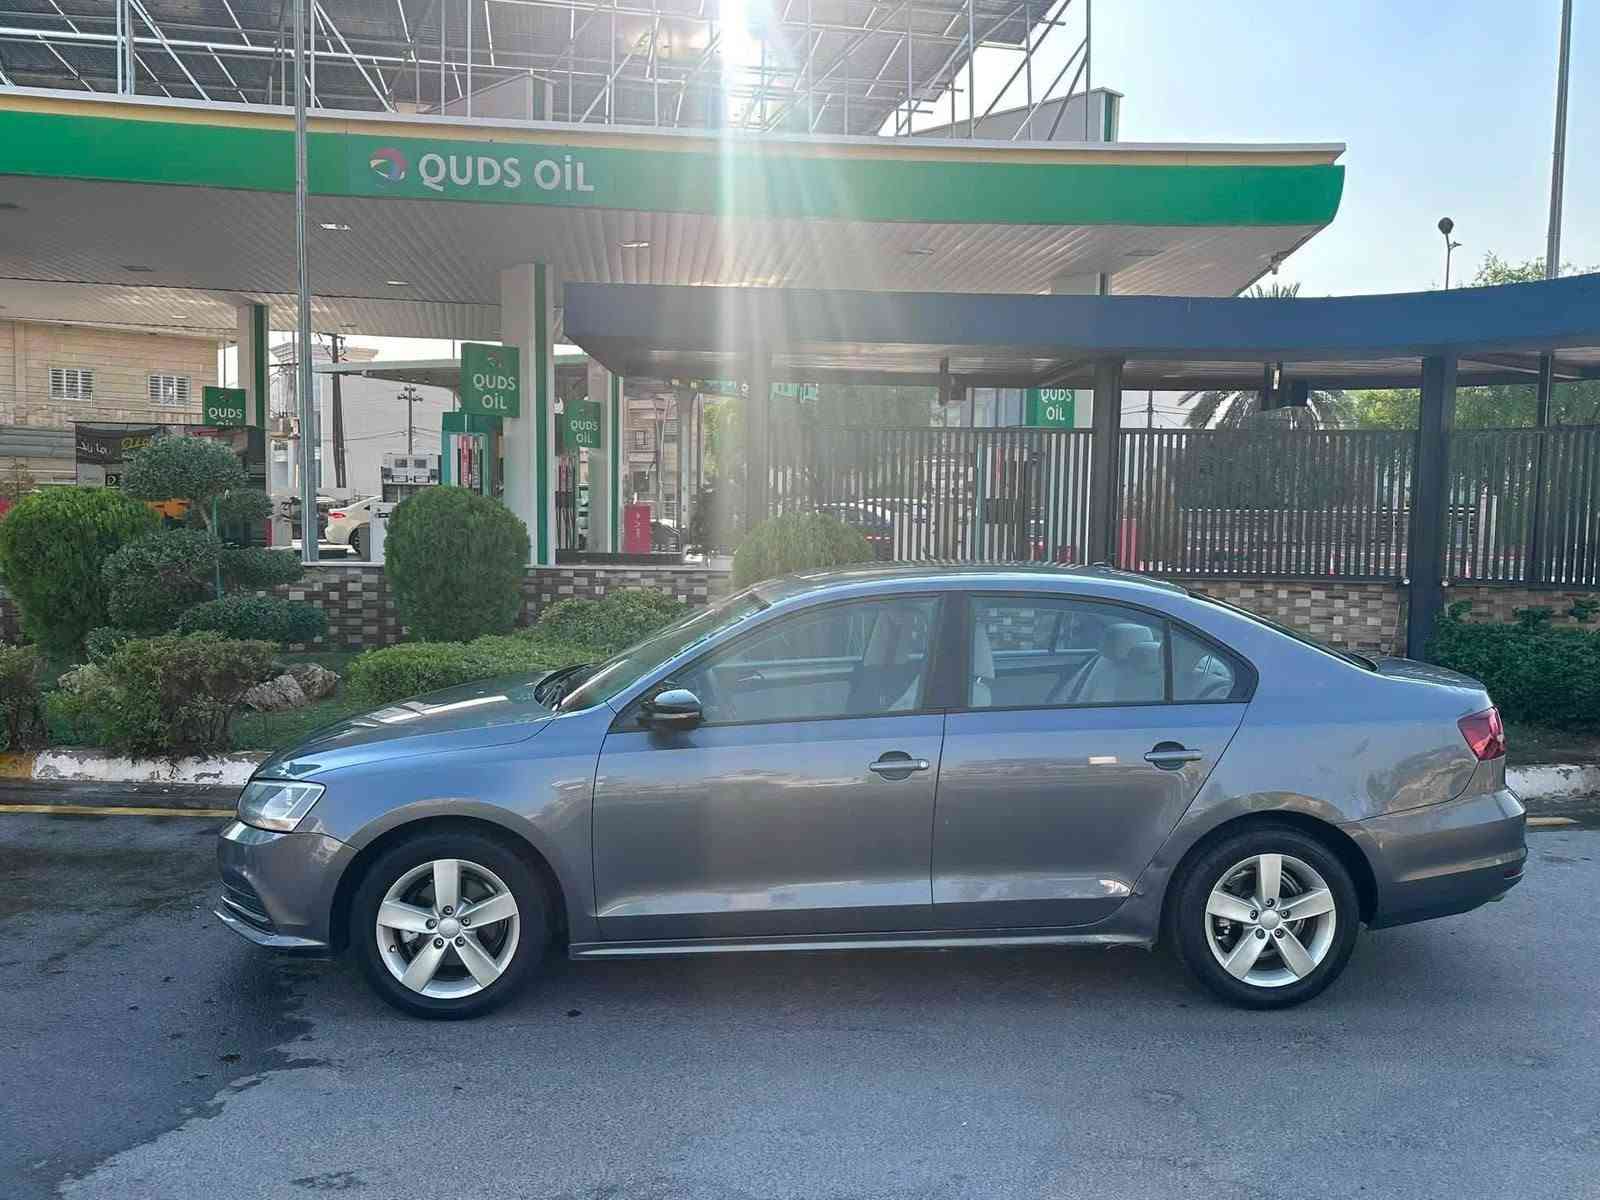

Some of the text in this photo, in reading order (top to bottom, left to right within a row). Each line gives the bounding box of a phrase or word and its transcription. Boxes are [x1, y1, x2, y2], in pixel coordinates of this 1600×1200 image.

[418, 153, 521, 192] QUDS
[472, 373, 516, 391] QUDS
[1040, 388, 1072, 403] QUDS
[208, 407, 243, 420] QUDS
[570, 420, 599, 431] QUDS
